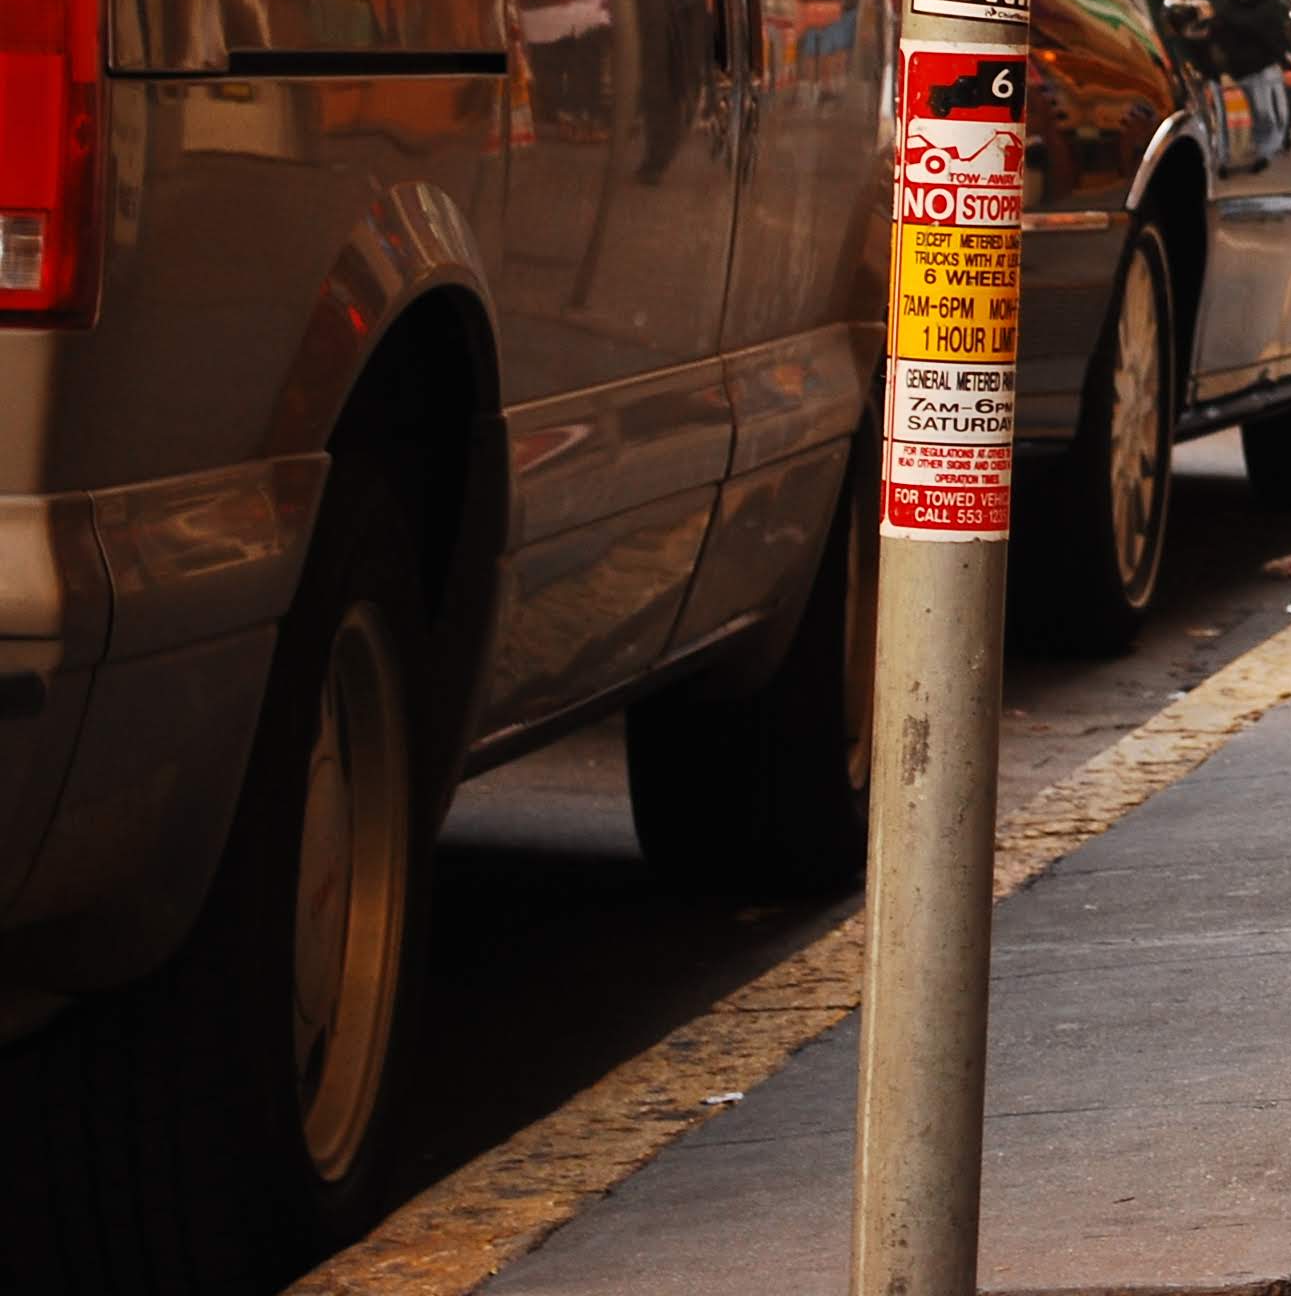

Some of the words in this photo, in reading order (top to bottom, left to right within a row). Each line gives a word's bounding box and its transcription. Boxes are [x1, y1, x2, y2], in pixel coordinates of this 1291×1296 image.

[991, 68, 1015, 99] 6
[903, 186, 955, 220] NO
[916, 231, 953, 248] EXCEPT
[914, 250, 960, 267] TRUCKS
[964, 252, 992, 267] WITH
[924, 268, 937, 285] 6
[945, 269, 1017, 288] WHEELS
[903, 294, 975, 319] 7AM-6PM
[923, 325, 930, 352] 1
[937, 325, 986, 354] HOUR
[906, 368, 952, 391] GENERAL
[956, 370, 1001, 393] METERED
[895, 488, 919, 505] FOR
[924, 490, 976, 507] TOWED
[914, 506, 951, 524] CALL
